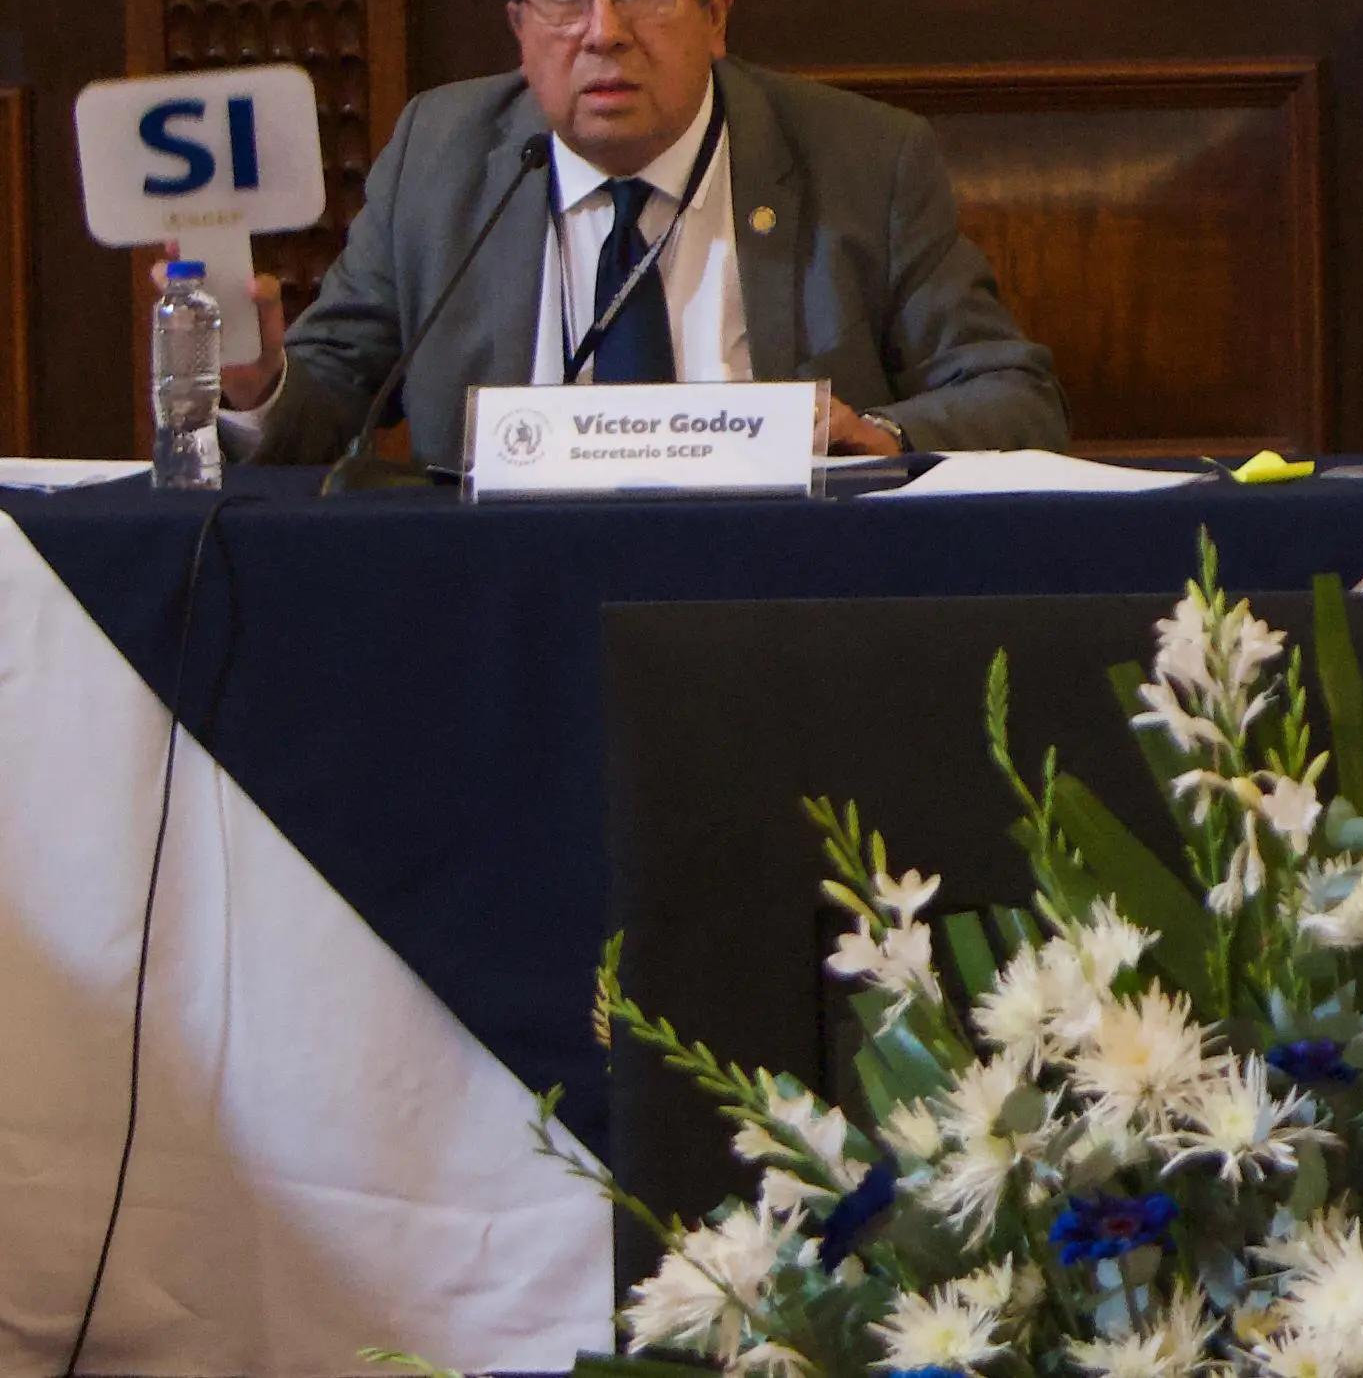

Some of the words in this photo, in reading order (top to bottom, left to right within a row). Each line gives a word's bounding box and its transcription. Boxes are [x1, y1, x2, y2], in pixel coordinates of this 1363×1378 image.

[139, 96, 259, 196] SI
[573, 411, 661, 435] Víctor
[669, 409, 764, 439] Godoy
[570, 443, 661, 460] Secretario
[666, 444, 713, 459] SCEP
